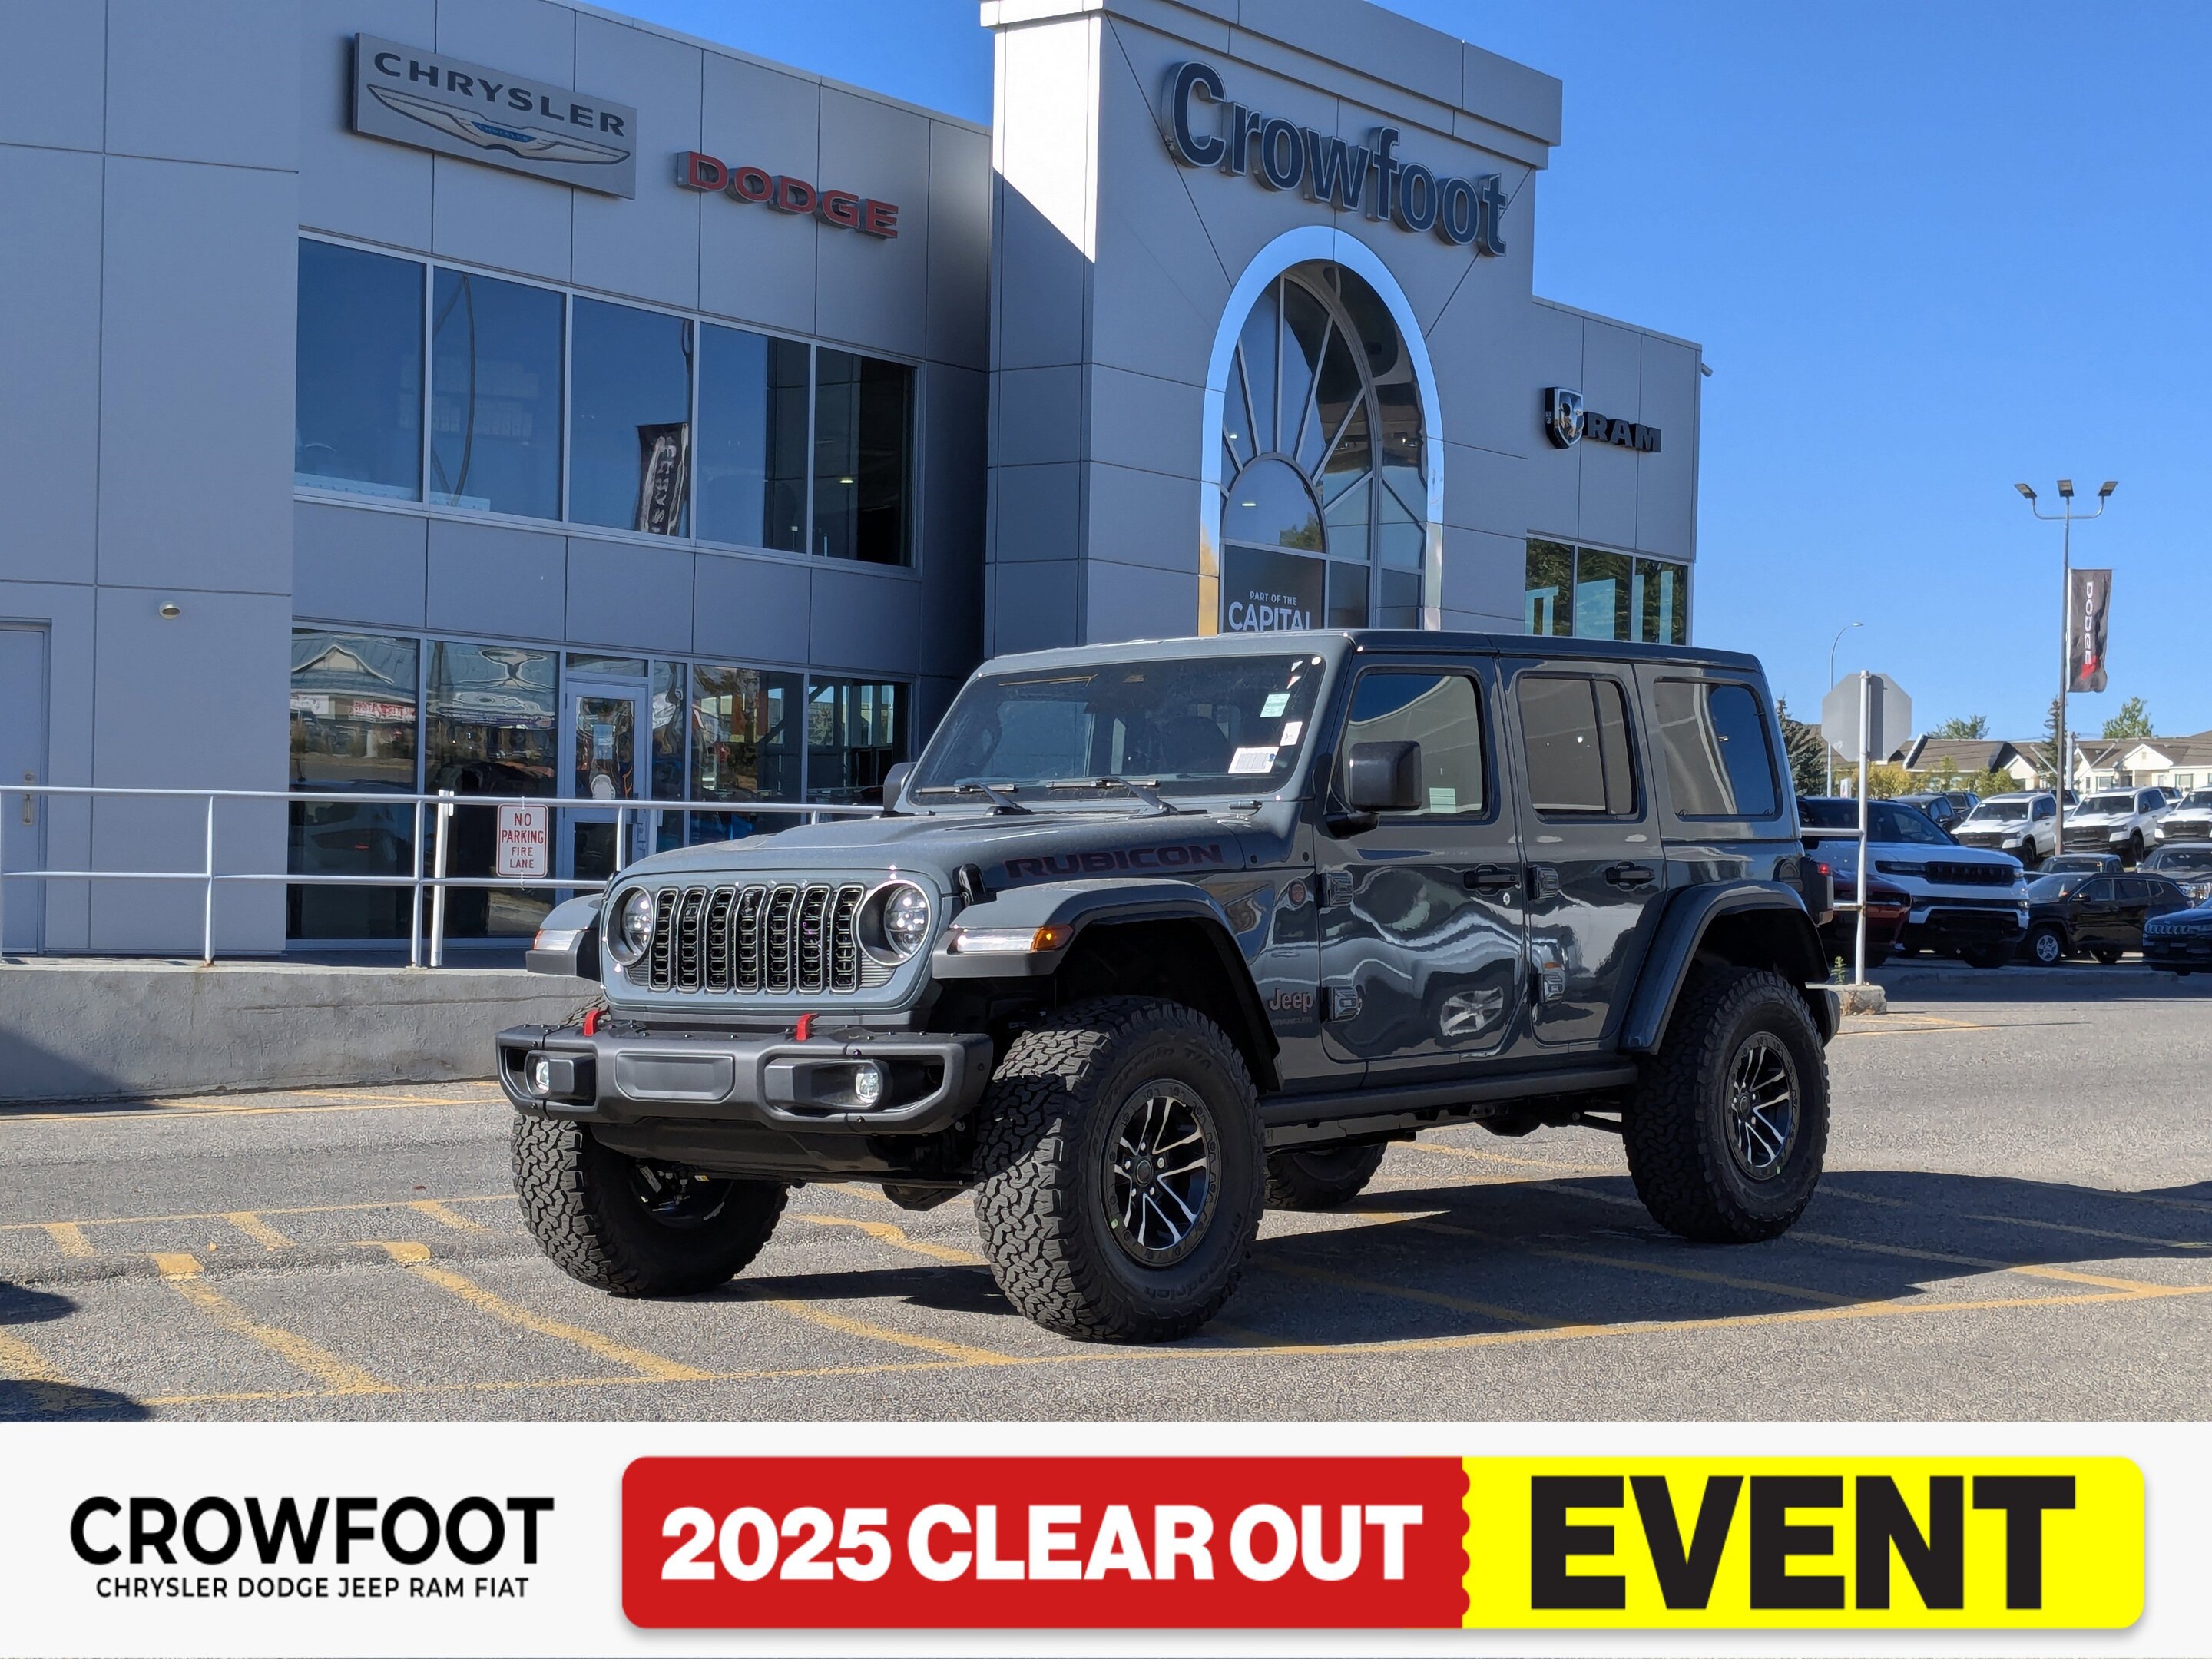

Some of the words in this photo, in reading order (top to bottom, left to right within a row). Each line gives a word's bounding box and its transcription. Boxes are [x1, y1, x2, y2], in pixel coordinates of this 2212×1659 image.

[374, 51, 625, 137] CHRYSLER
[1171, 61, 1508, 257] Crowfoot
[686, 151, 899, 239] DODGE
[1587, 412, 1662, 453] RAM
[1250, 591, 1269, 602] PART
[1271, 594, 1281, 604] OF
[1283, 595, 1297, 606] THE
[2084, 581, 2094, 665] DODGE
[514, 813, 532, 826] NO
[502, 830, 544, 844] PARKING
[512, 846, 533, 856] FIRE
[509, 859, 535, 869] LANE
[1003, 843, 1224, 879] RUBICON
[1269, 988, 1314, 1014] Jeep
